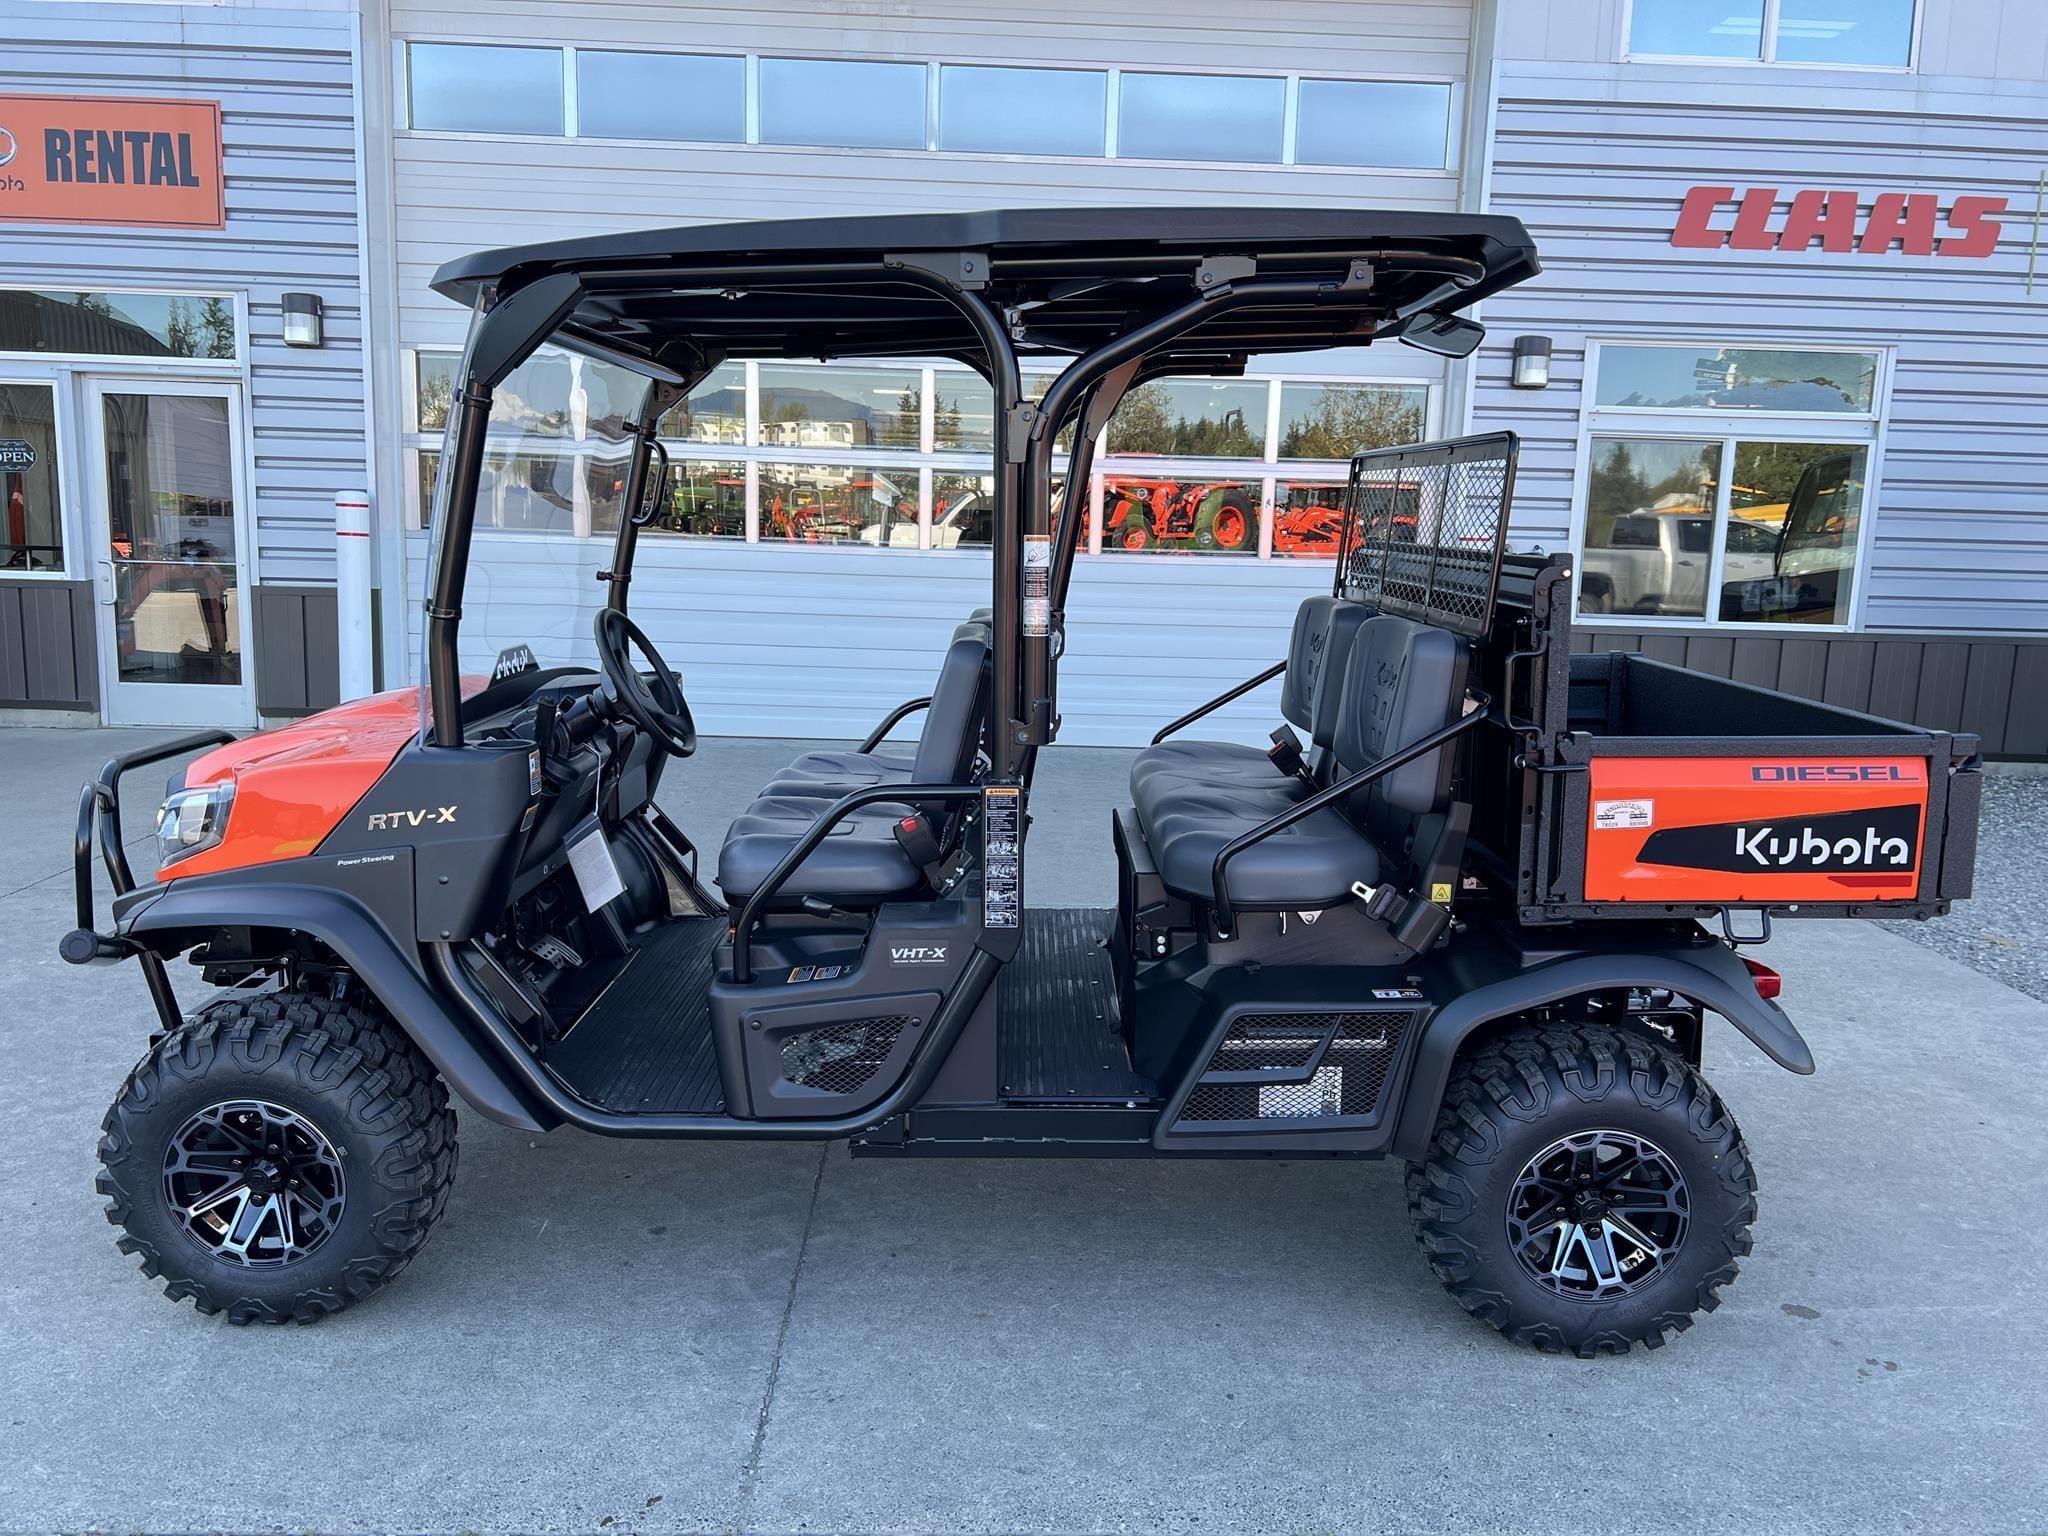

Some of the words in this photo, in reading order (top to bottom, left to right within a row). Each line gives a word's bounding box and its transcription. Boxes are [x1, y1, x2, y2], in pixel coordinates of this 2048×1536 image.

[44, 128, 200, 188] RENTAL
[1670, 186, 2009, 258] CLAAS
[0, 451, 34, 463] PEN
[1752, 766, 1920, 781] DIESEL
[367, 805, 458, 831] RTV-X
[1735, 827, 1909, 865] Kubota
[361, 855, 395, 863] Steering
[891, 947, 947, 959] VHT-X
